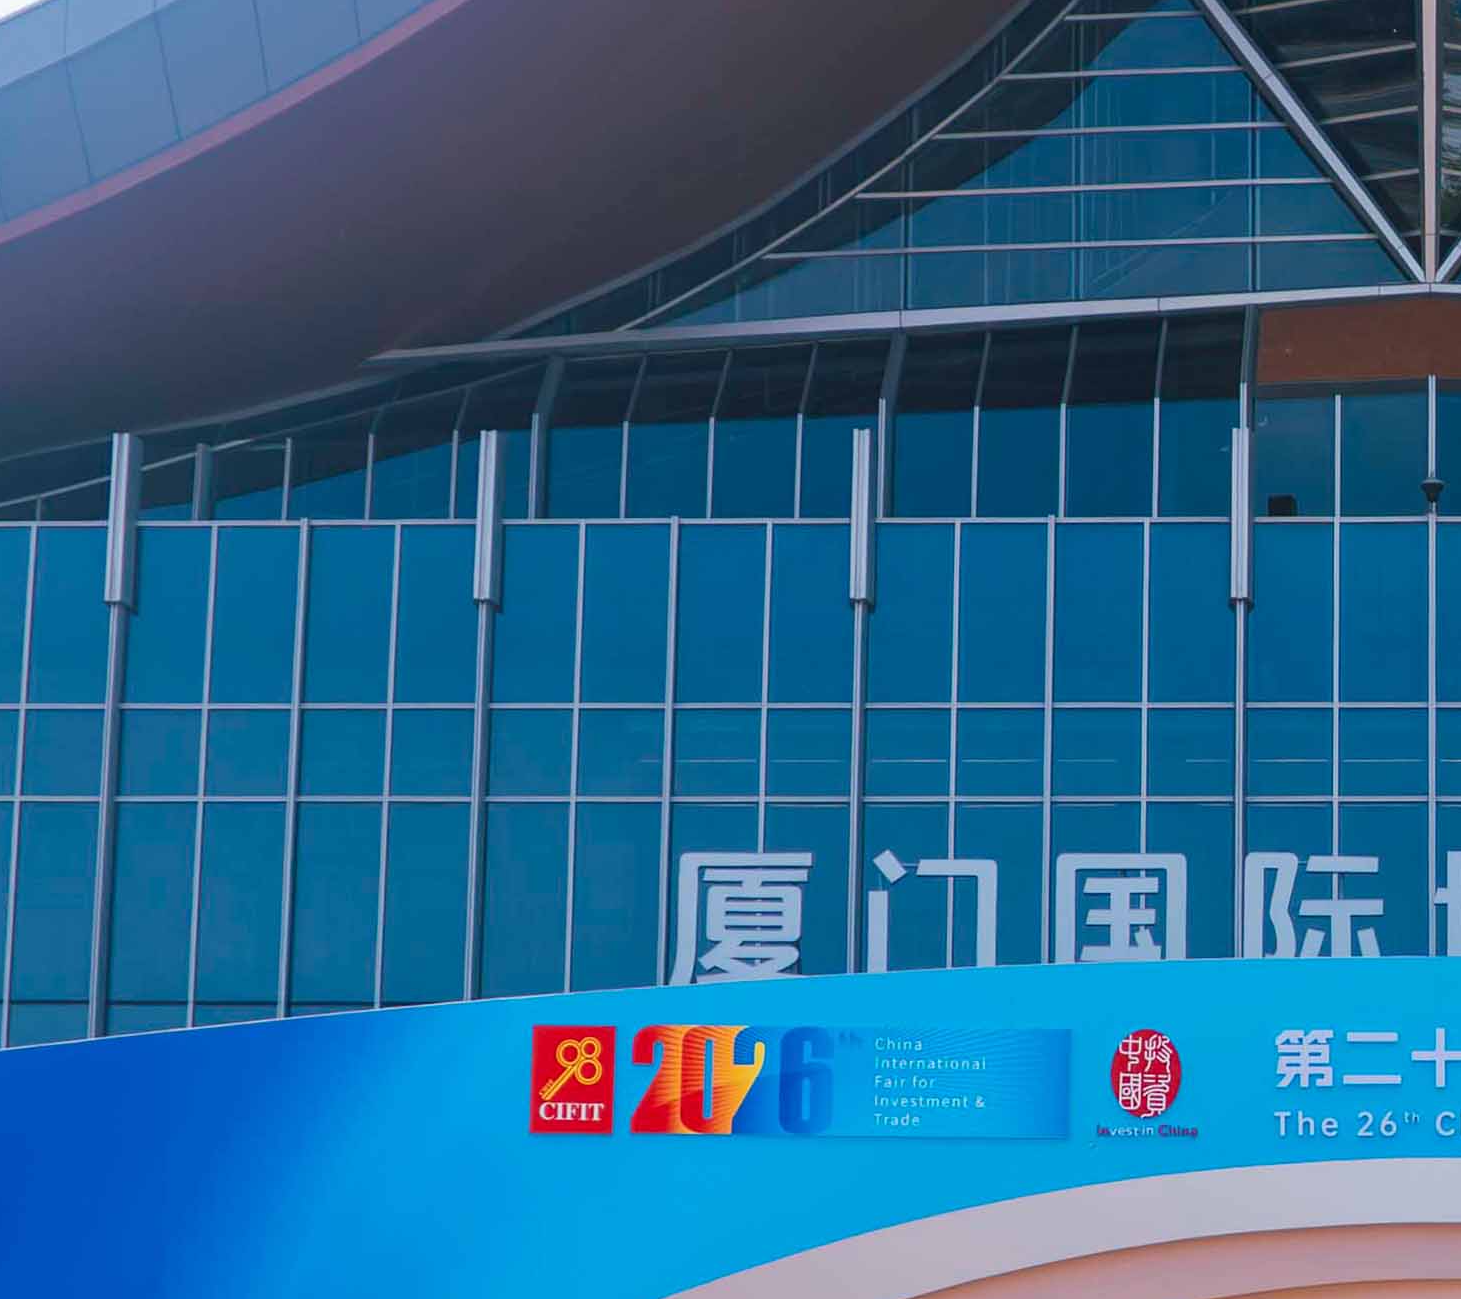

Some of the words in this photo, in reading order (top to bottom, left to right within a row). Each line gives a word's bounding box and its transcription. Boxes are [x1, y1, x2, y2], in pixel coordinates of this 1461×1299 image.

[874, 1036, 923, 1051] China
[874, 1057, 987, 1071] International
[874, 1075, 906, 1089] Fair
[912, 1075, 936, 1089] for
[874, 1094, 968, 1108] Investment
[538, 1102, 605, 1121] CIFIT
[874, 1112, 920, 1127] Trade
[1274, 1111, 1339, 1137] The
[1357, 1111, 1421, 1137] 26th
